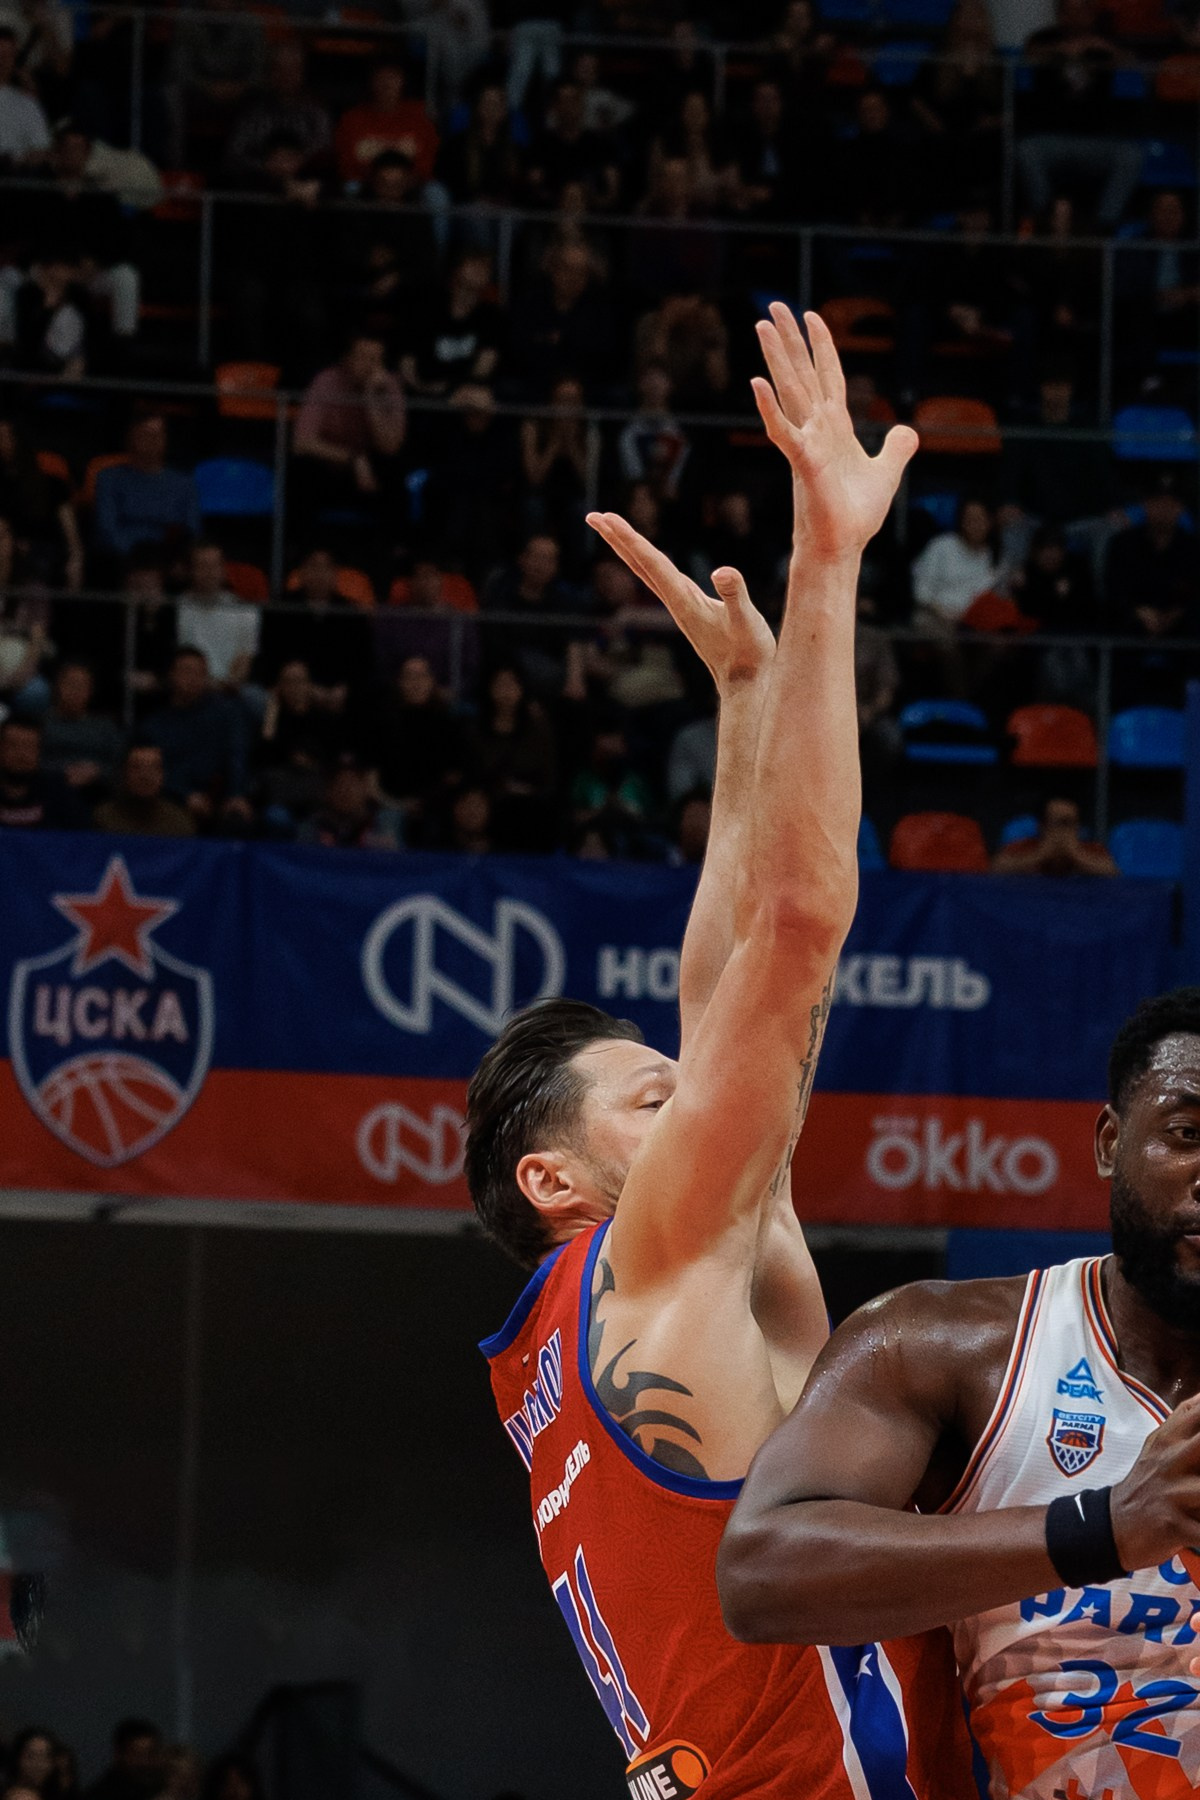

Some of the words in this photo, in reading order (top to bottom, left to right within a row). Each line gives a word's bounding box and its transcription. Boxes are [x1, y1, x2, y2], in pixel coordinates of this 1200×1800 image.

[599, 945, 991, 1010] НОКЕЛЬ
[34, 985, 190, 1046] ЦСКА
[1056, 1378, 1104, 1405] PEAK
[1061, 1421, 1095, 1431] PARMA
[1026, 1659, 1200, 1758] 32
